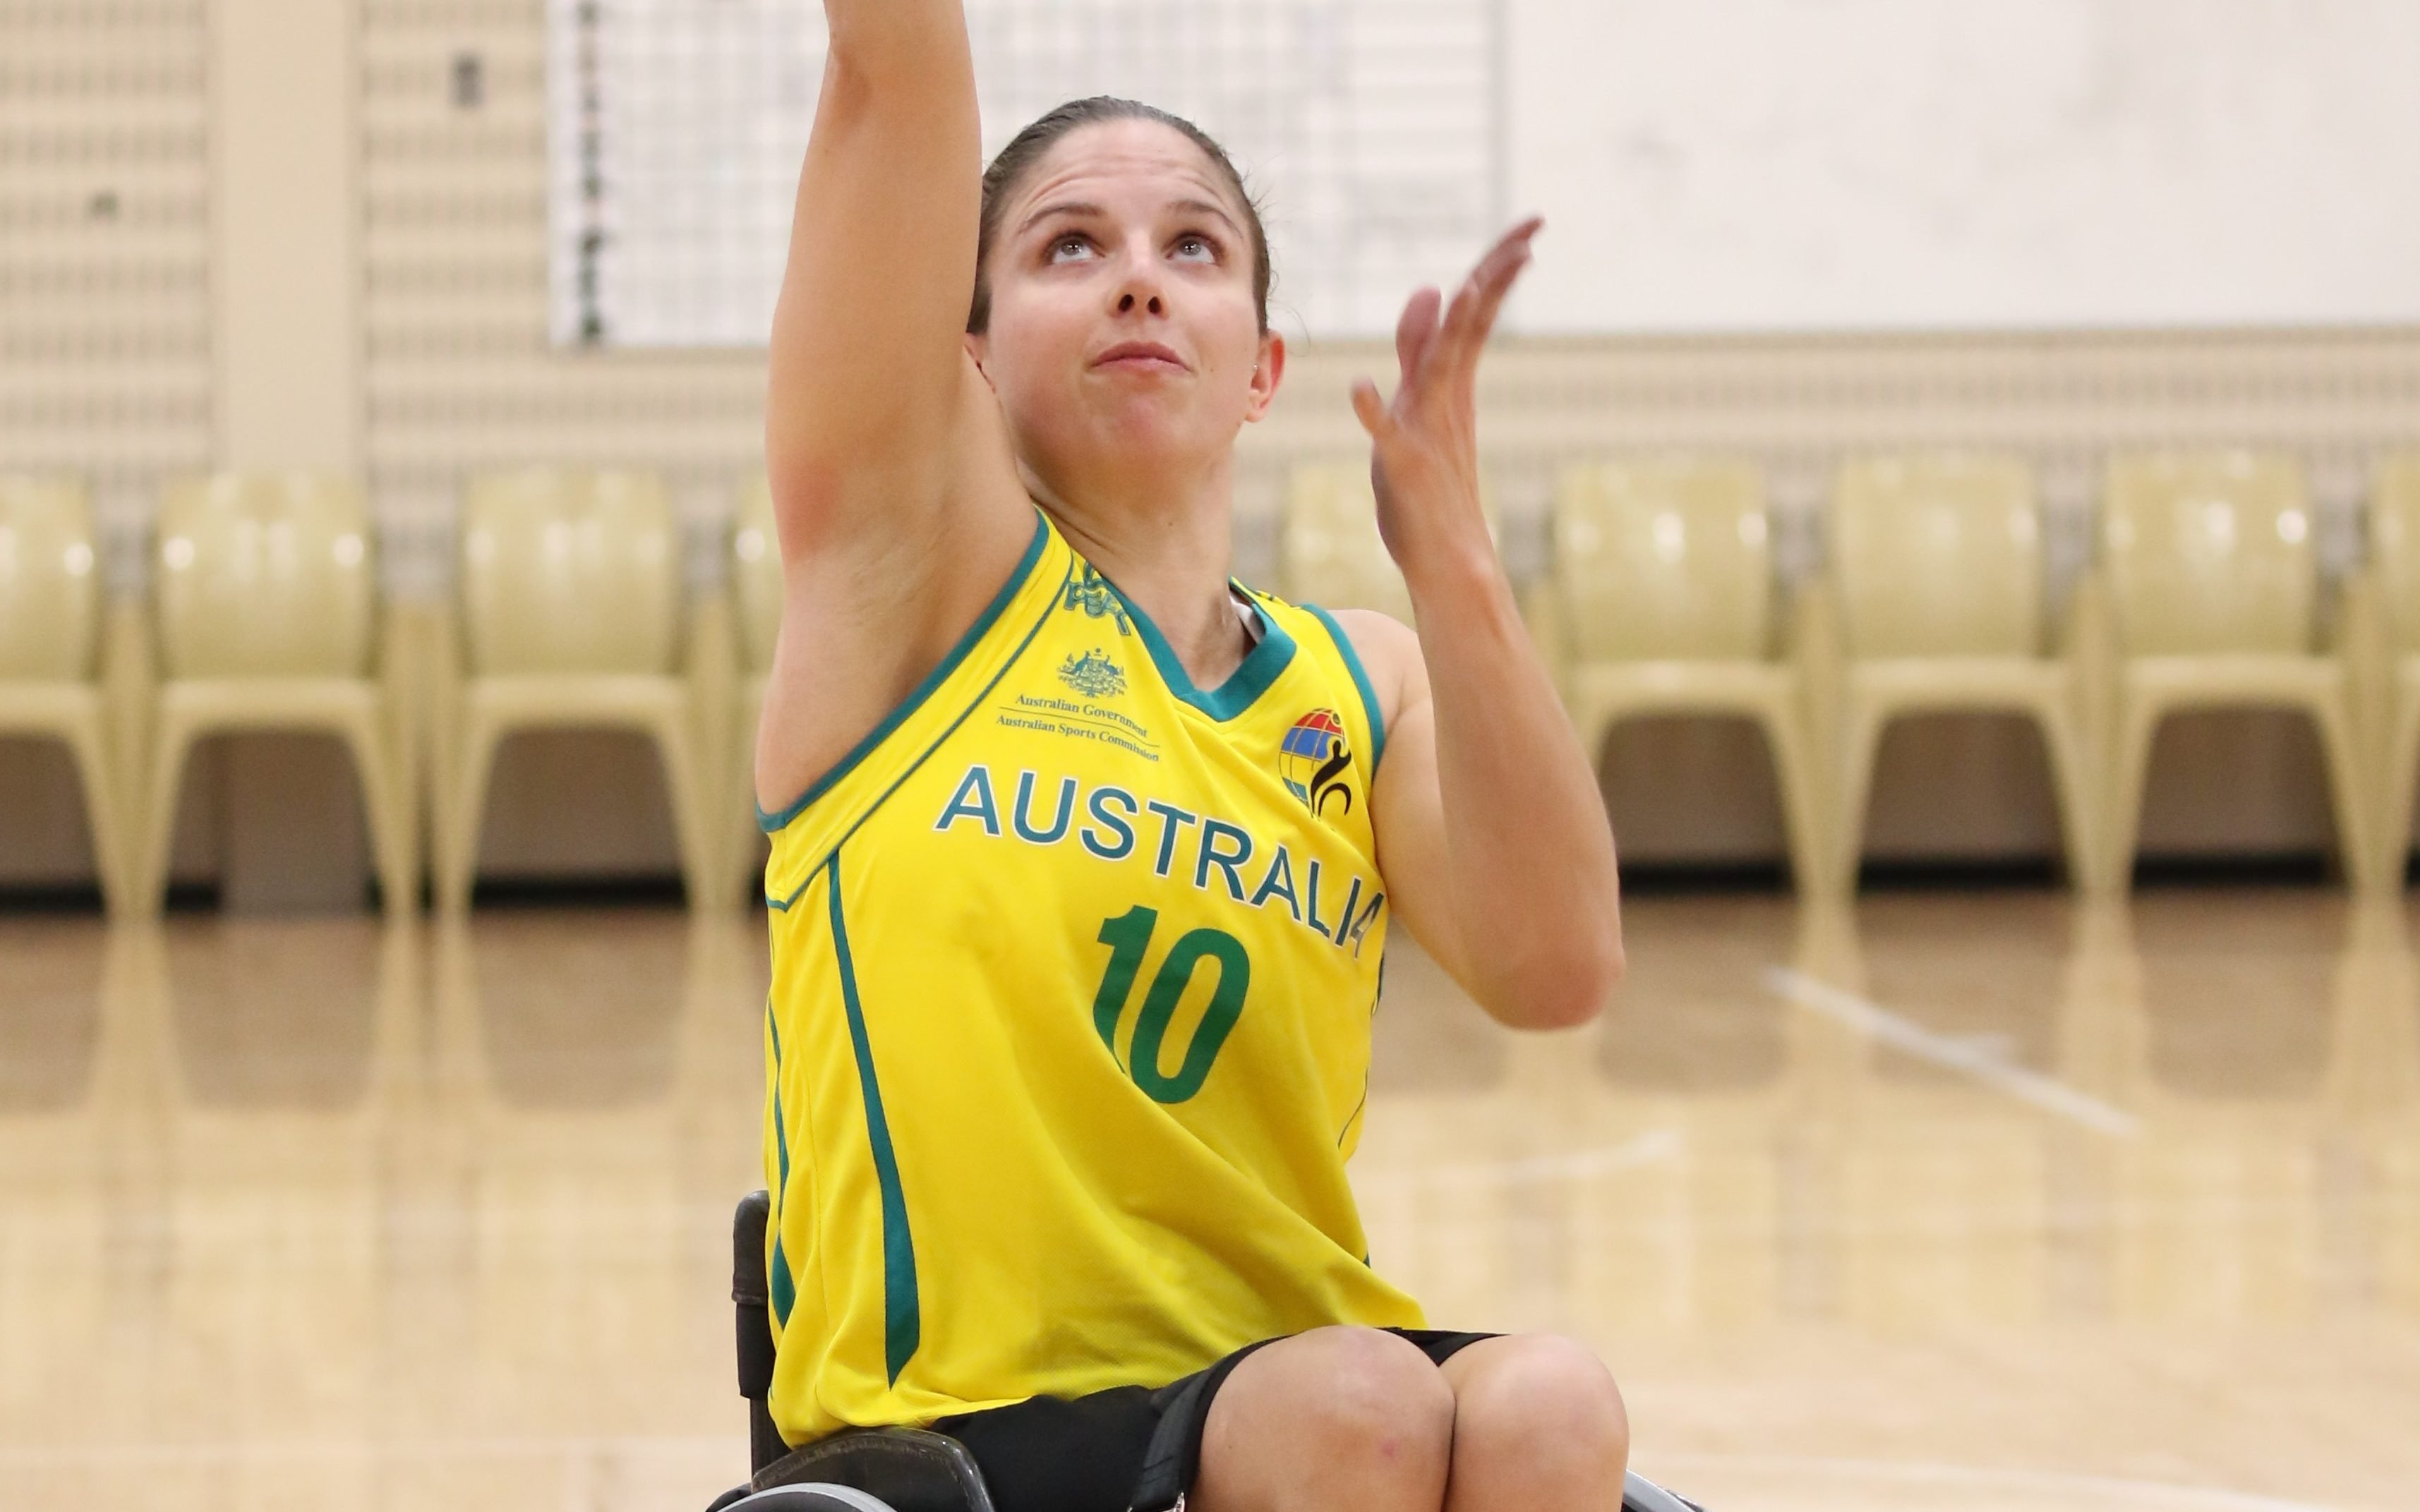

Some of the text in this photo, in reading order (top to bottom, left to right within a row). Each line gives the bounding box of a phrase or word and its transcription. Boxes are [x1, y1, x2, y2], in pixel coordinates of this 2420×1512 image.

[996, 714, 1160, 762] Australian Sports Commission
[1015, 694, 1148, 738] Australian Government
[934, 764, 1386, 960] AUSTRALIA
[1093, 904, 1251, 1105] 10
